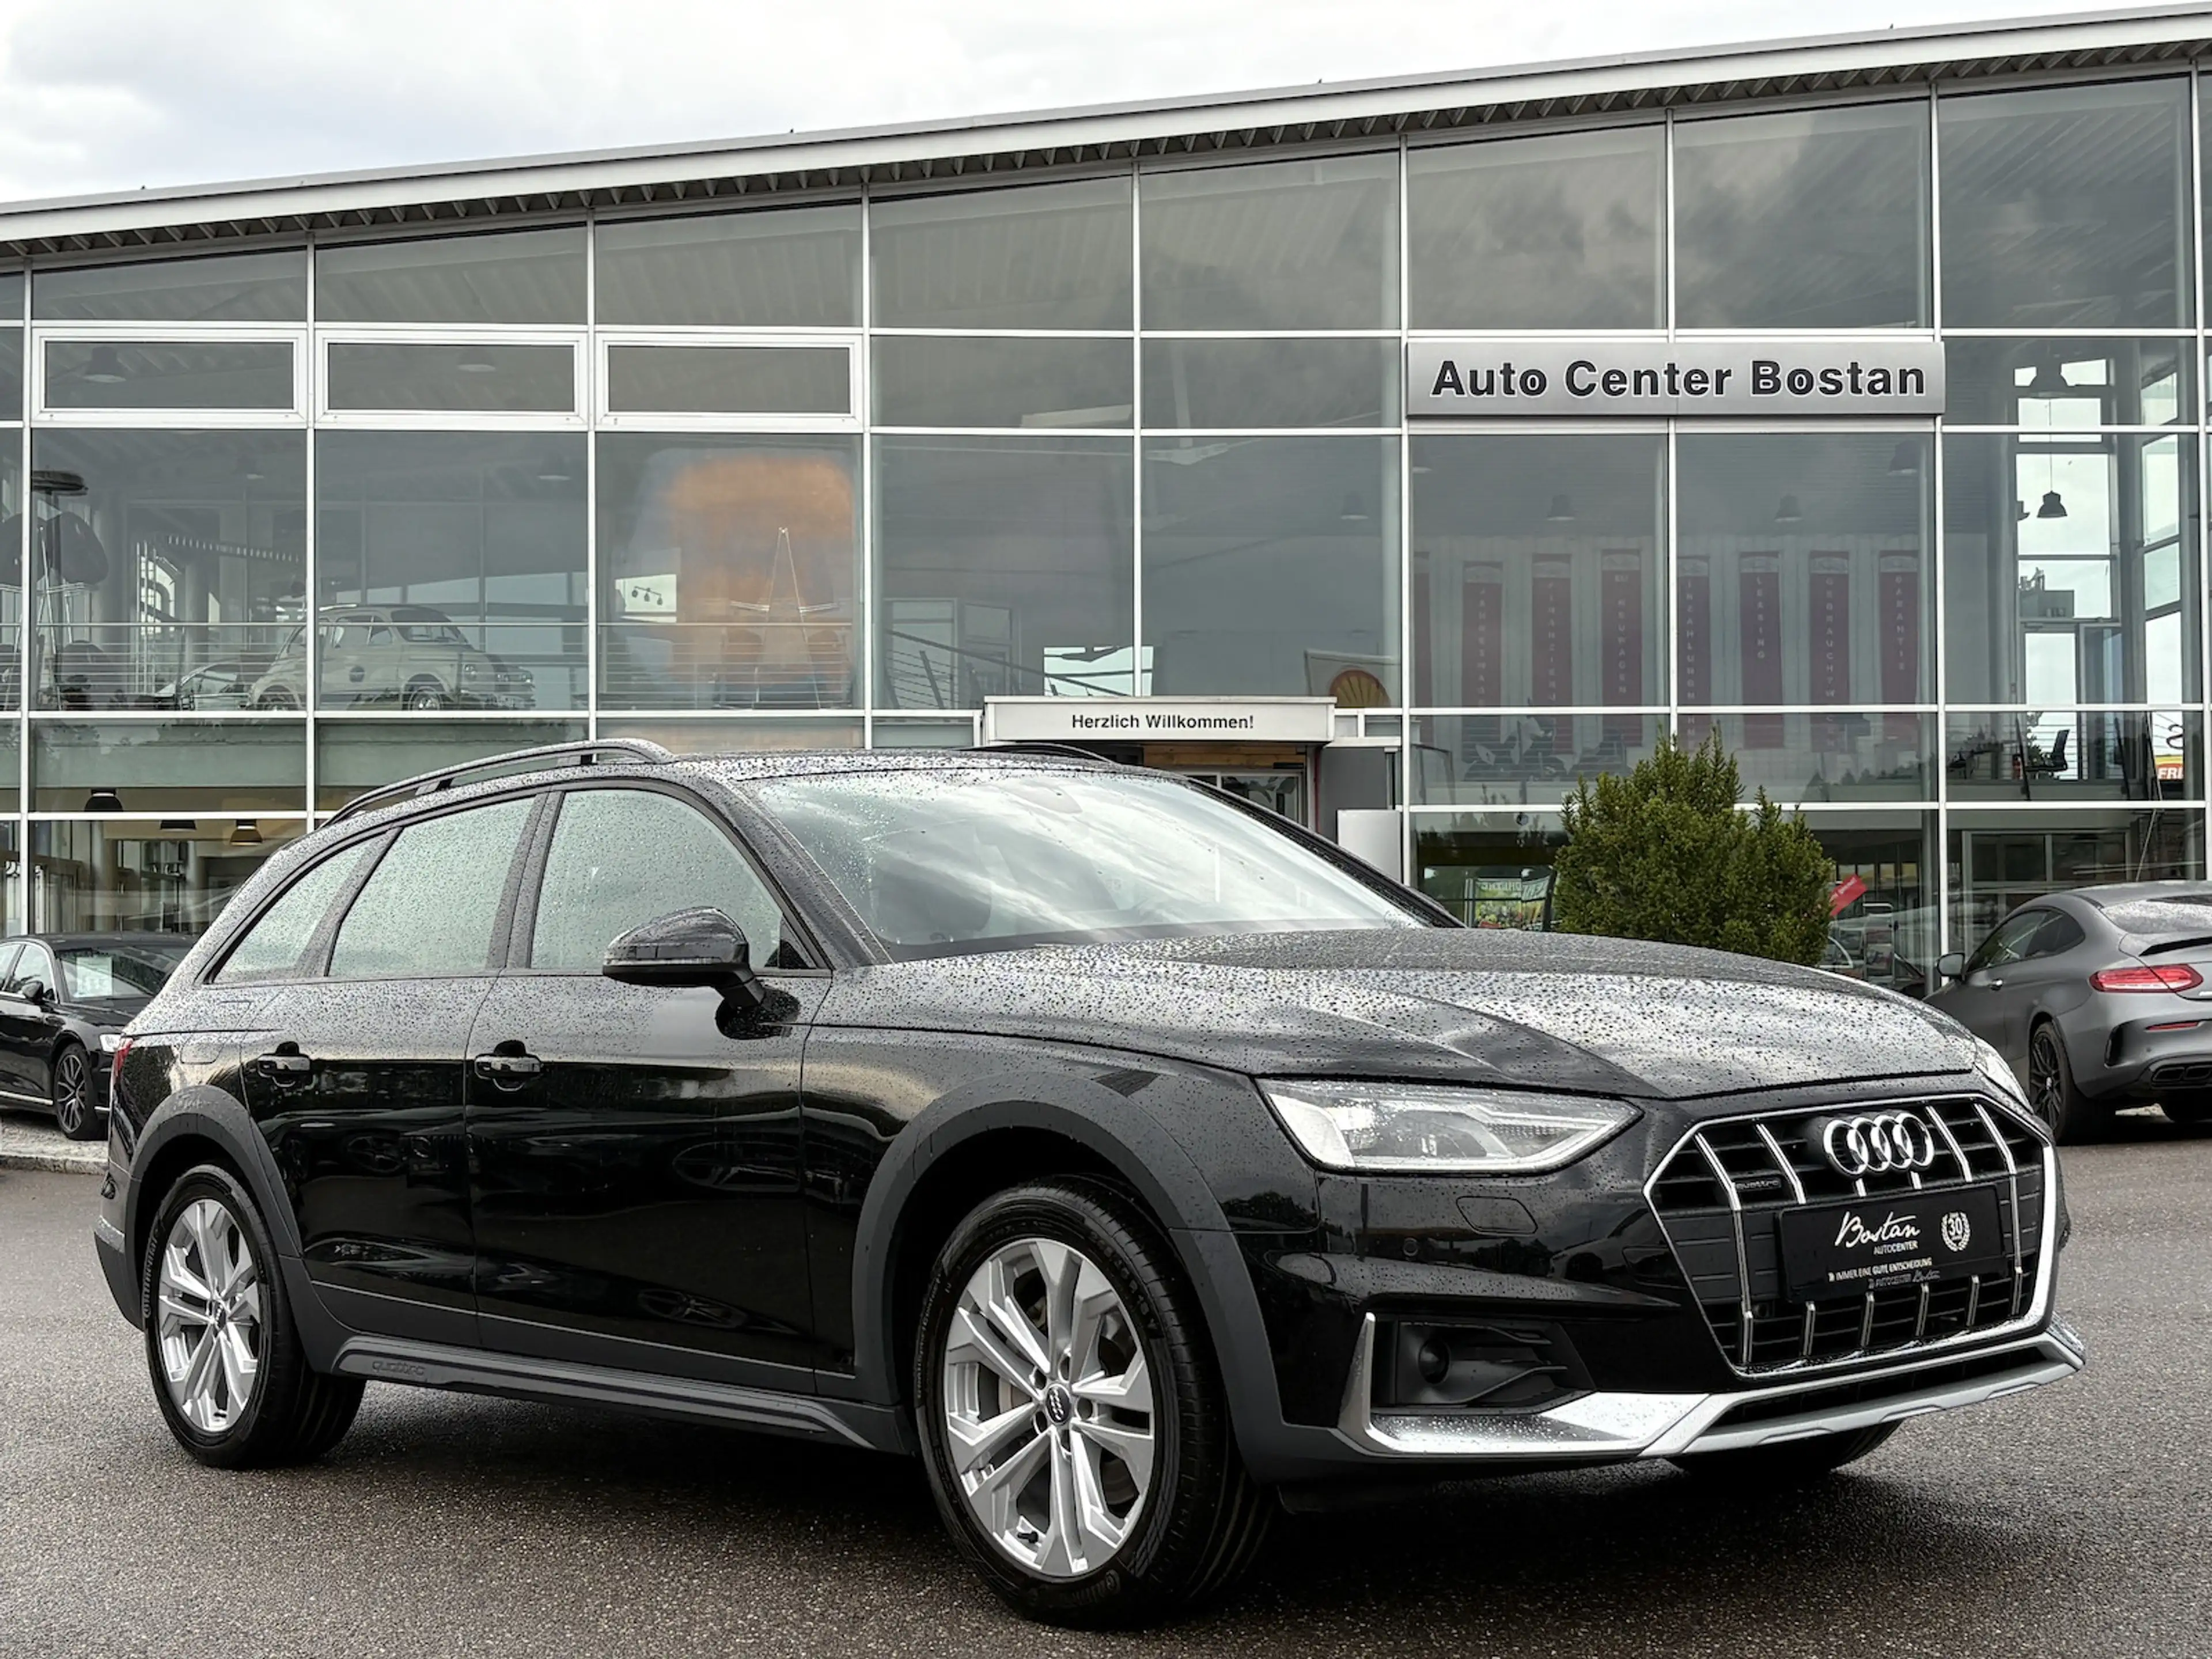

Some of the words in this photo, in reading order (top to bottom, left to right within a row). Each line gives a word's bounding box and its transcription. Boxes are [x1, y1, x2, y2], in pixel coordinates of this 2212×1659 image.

[1432, 361, 1547, 396] Auto
[1565, 361, 1732, 396] Center
[1752, 361, 1925, 396] Bostan
[1071, 714, 1140, 729] Herzlich
[1145, 714, 1254, 729] Willkommen!
[1834, 1211, 1921, 1249] Bostan
[1948, 1217, 1963, 1236] 30
[1873, 1240, 1919, 1255] AUTOCENTER
[372, 1360, 426, 1376] quattro
